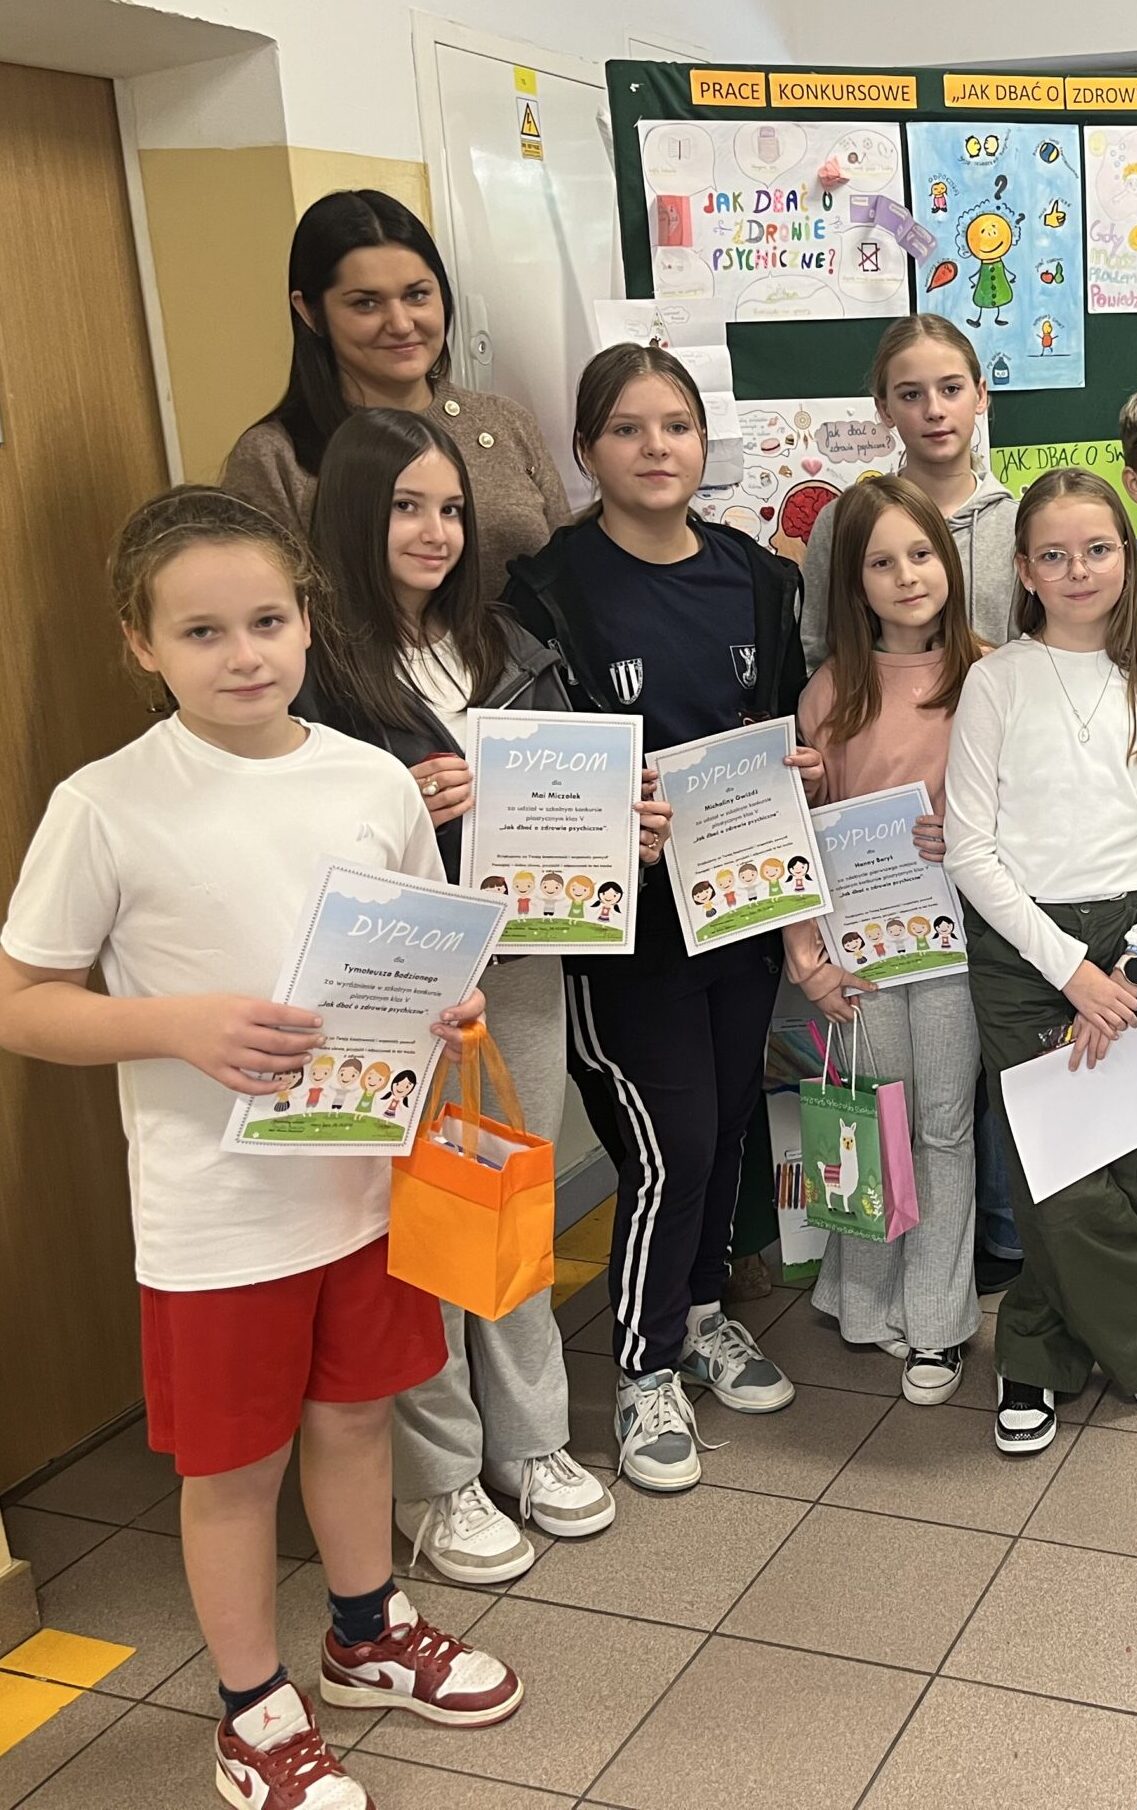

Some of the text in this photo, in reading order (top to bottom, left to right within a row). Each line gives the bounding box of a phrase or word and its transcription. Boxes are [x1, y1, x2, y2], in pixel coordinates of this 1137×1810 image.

[700, 82, 760, 100] PRACE
[778, 83, 910, 102] KONKURSOWE
[996, 82, 1041, 100] DBAĆ
[1046, 86, 1059, 102] O
[704, 183, 833, 214] JAK DBAĆ O
[731, 216, 826, 245] ZDROWIE
[1090, 220, 1124, 258] Gdy
[712, 246, 836, 274] PSYCHICZNE?
[823, 423, 840, 448] Jak
[996, 448, 1031, 484] JAK
[1036, 444, 1080, 470] DBAĆ
[1086, 446, 1098, 466] O
[506, 749, 608, 772] DYPLOM
[687, 752, 767, 793] DYPLOM
[705, 799, 734, 811] Michaliny
[825, 818, 907, 852] DYPLOM
[855, 860, 875, 868] Hanny
[348, 915, 465, 952] DYPLOM
[344, 963, 393, 977] Tymoteusza
[413, 988, 442, 997] konkursie
